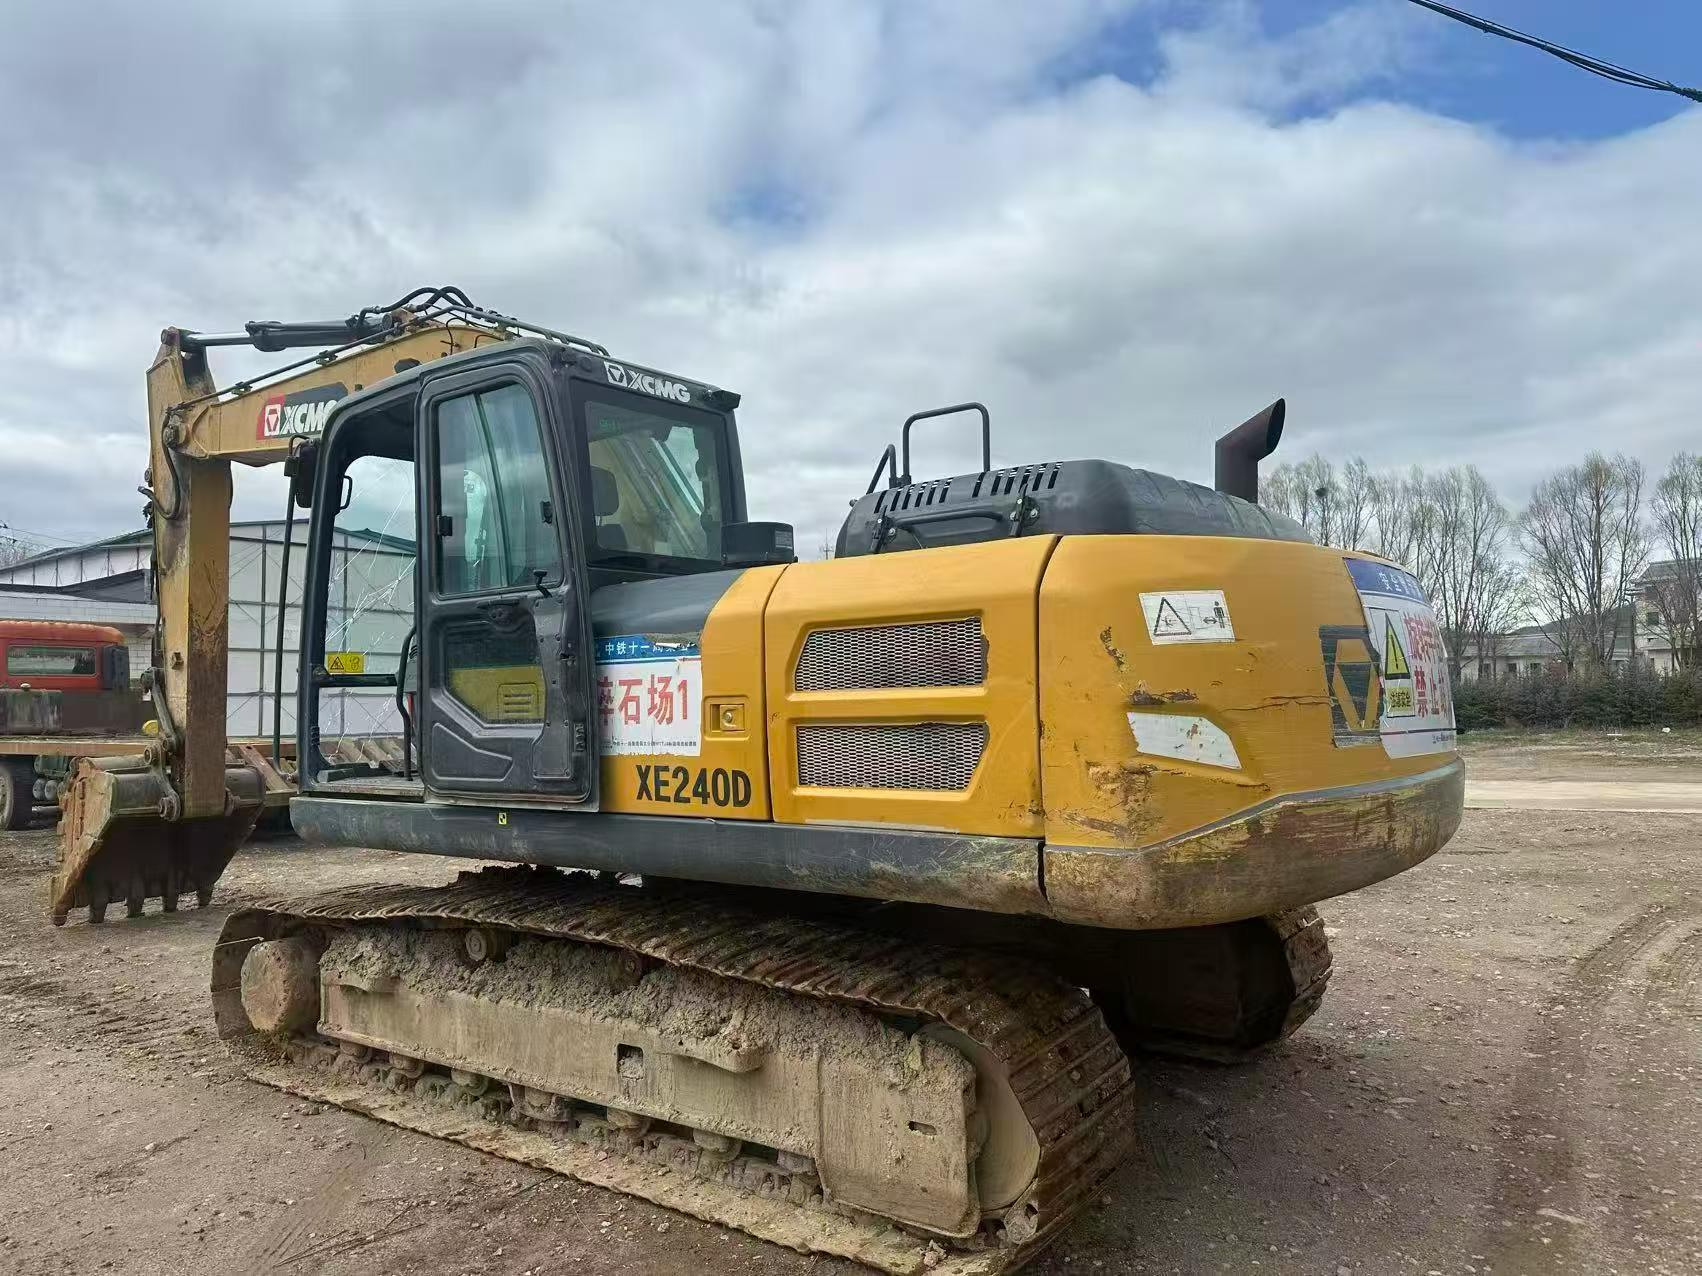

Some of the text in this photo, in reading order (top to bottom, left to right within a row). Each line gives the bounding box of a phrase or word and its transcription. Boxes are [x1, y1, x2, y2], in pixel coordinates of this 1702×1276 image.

[627, 369, 691, 403] XCMG
[605, 640, 688, 655] 中铁十一
[636, 764, 752, 808] XE240D
